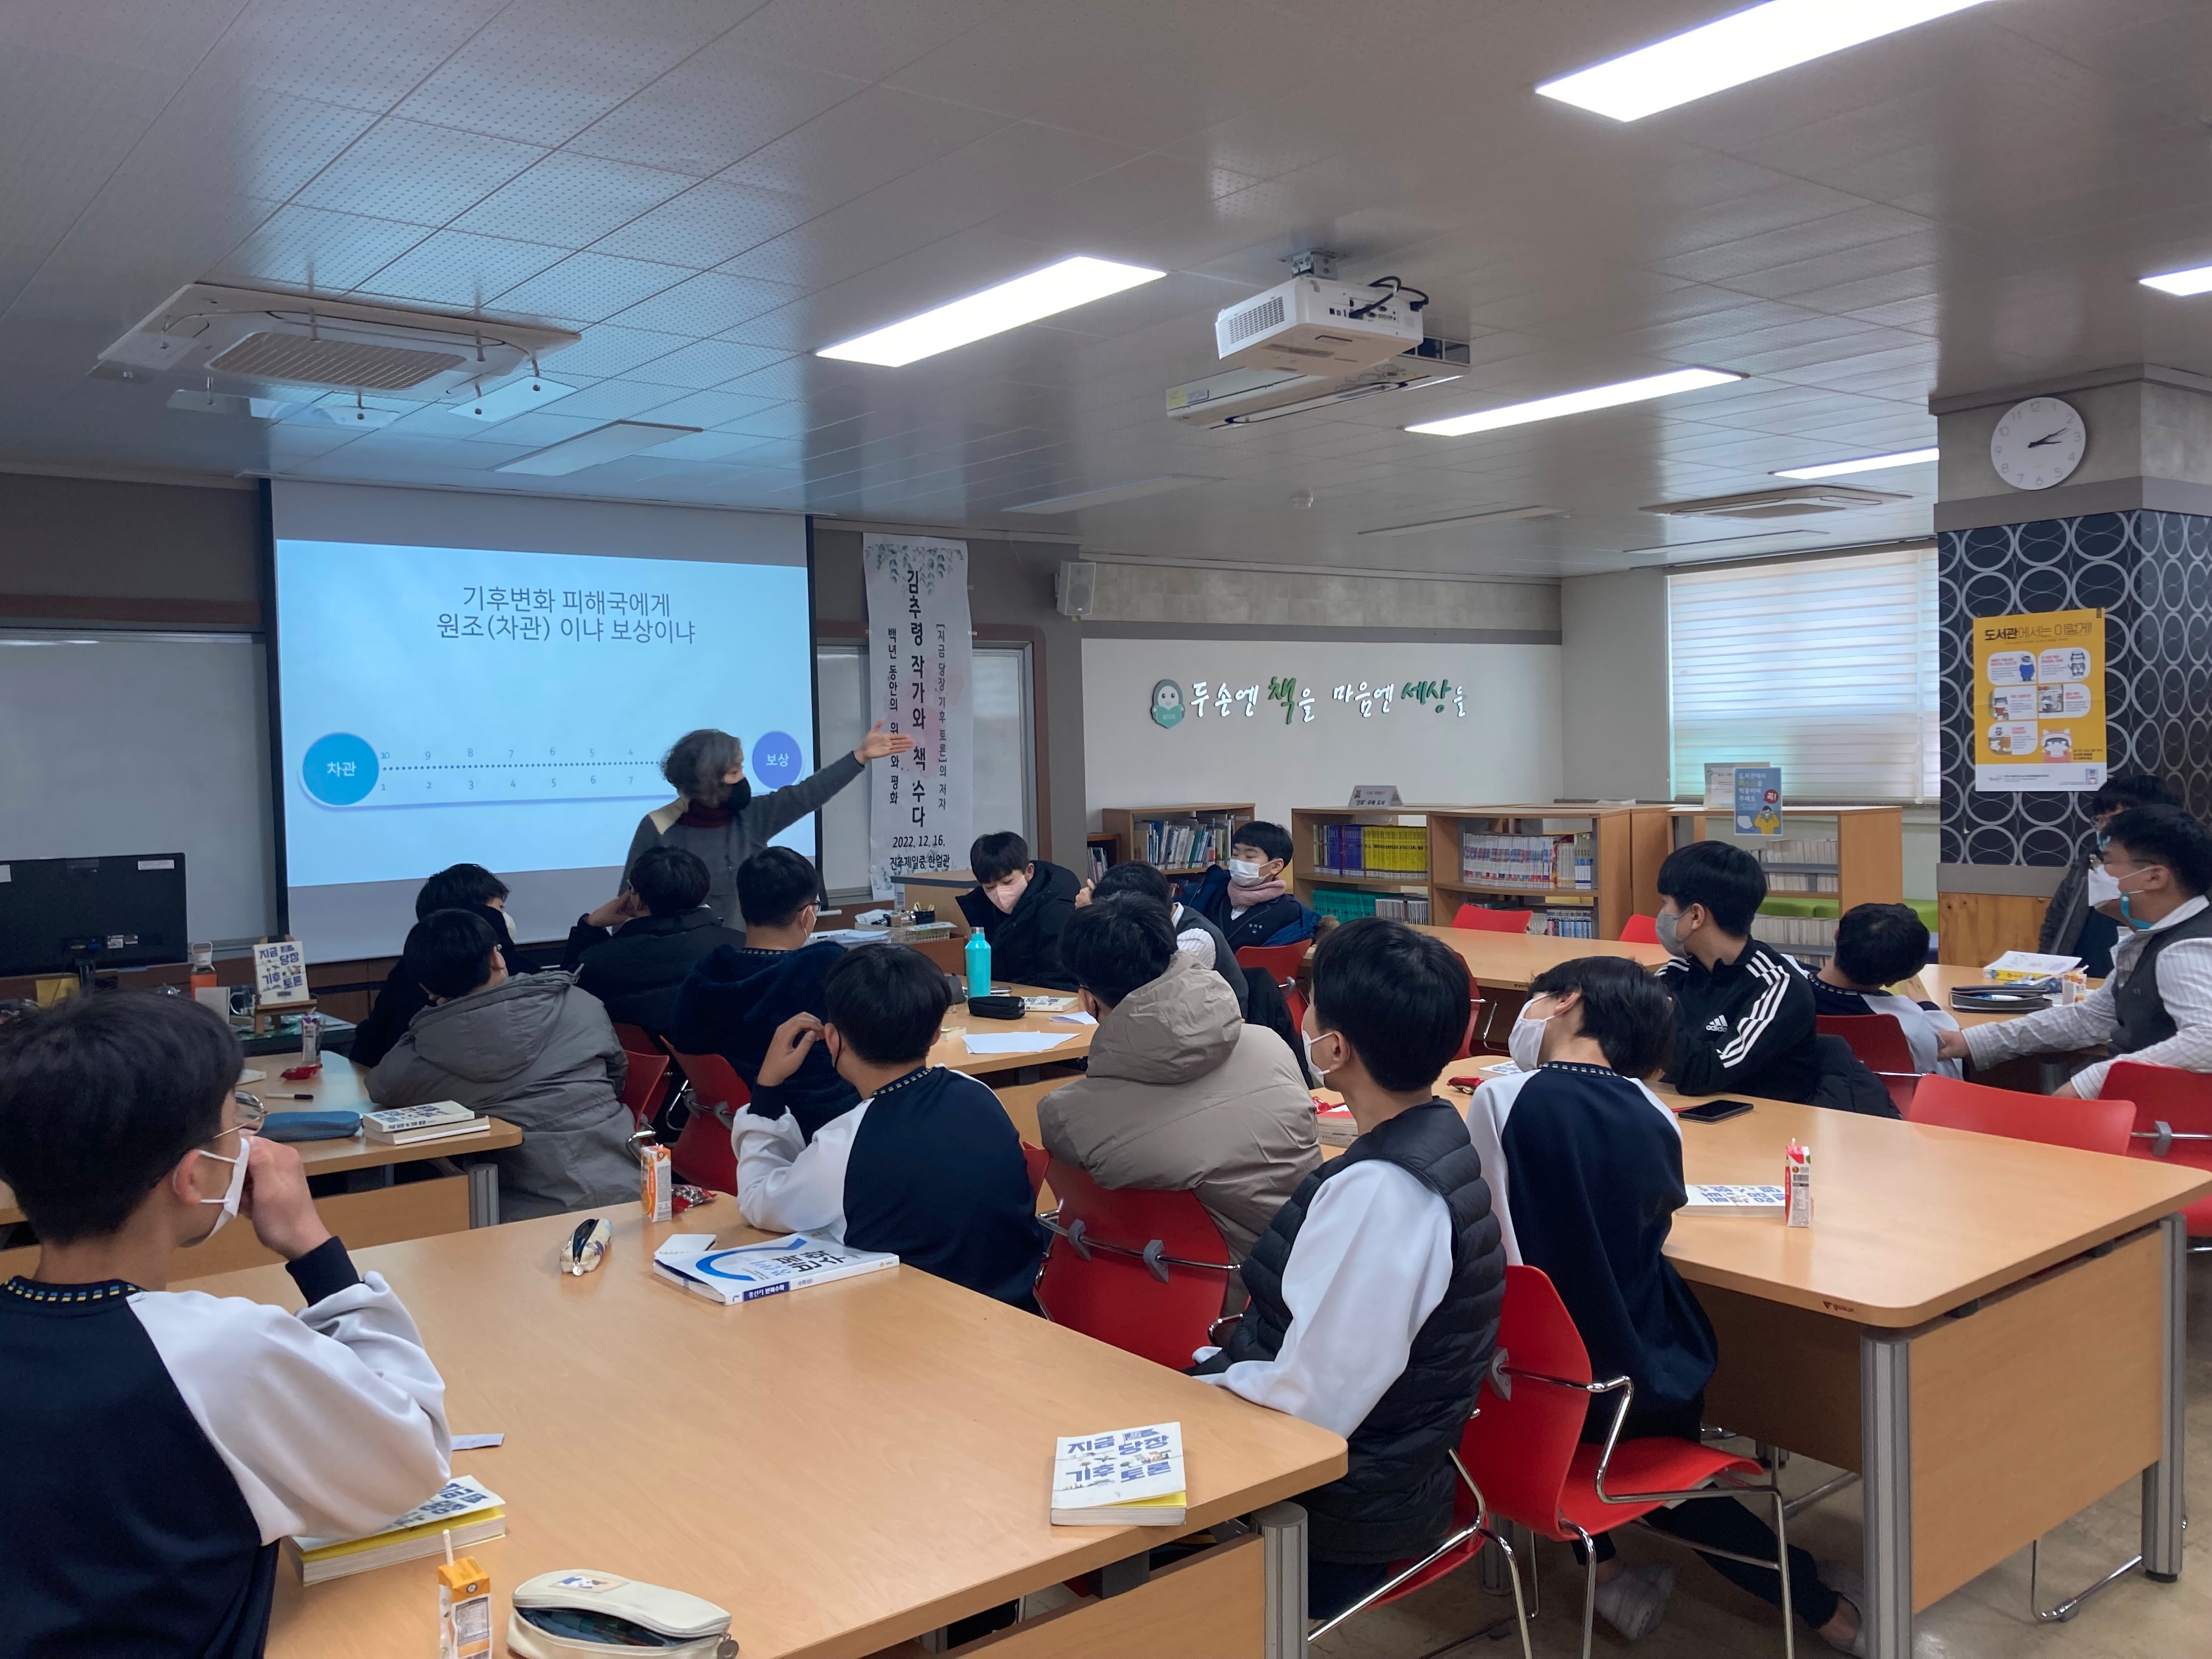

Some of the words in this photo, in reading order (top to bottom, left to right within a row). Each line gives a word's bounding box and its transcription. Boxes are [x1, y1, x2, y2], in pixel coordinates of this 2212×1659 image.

[2030, 401, 2040, 412] 12
[2052, 402, 2057, 411] 1
[2011, 411, 2021, 421] 11
[2067, 413, 2074, 424] 2
[1999, 426, 2009, 437] 10
[2073, 431, 2081, 442] 3
[1994, 445, 2002, 455] 9
[2068, 452, 2075, 462] 4
[2001, 463, 2009, 473] 8
[2054, 467, 2063, 478] 5
[2017, 473, 2024, 484] 7
[2035, 476, 2043, 486] 6
[464, 585, 555, 613] 기후변화
[562, 590, 670, 617] 피해국에게
[907, 570, 923, 646] 김추령
[437, 613, 550, 642] 원조(차관)
[561, 617, 604, 642] 이냐
[611, 619, 696, 644] 보상이냐
[1984, 625, 2052, 641] 도서관에서는
[888, 628, 897, 660] 백년
[938, 663, 946, 691] 당장
[889, 665, 898, 712] 동안의
[911, 655, 926, 730] 작가와
[1190, 681, 1210, 718] 두
[1215, 682, 1261, 718] 손엔
[1268, 676, 1316, 725] 책을
[1332, 681, 1395, 719] 마음엔
[1401, 679, 1467, 718] 세상을
[938, 697, 947, 724] 기후
[890, 722, 899, 769] 위와
[425, 751, 431, 761] 9
[467, 748, 473, 758] 8
[509, 749, 514, 759] 7
[550, 747, 555, 756] 6
[590, 748, 595, 757] 5
[766, 752, 789, 768] 보상
[913, 746, 926, 771] 책
[326, 761, 357, 777] 차관
[468, 781, 474, 790] 3
[510, 779, 516, 788] 4
[551, 778, 556, 788] 5
[590, 775, 596, 784] 6
[628, 776, 634, 786] 7
[890, 775, 899, 805] 평화
[912, 780, 926, 827] 수다
[939, 784, 947, 811] 저자
[892, 836, 916, 849] 2022.
[918, 835, 931, 848] 12.
[933, 834, 945, 848] 16.
[890, 856, 926, 872] 진주제일중
[259, 947, 278, 960] 지금
[280, 951, 300, 966] 당장
[262, 972, 281, 985] 기후
[283, 975, 303, 990] 토론
[1068, 1435, 1115, 1453] 지금
[1118, 1435, 1170, 1456] 당장
[1065, 1463, 1115, 1482] 기후
[1120, 1461, 1172, 1483] 토론
